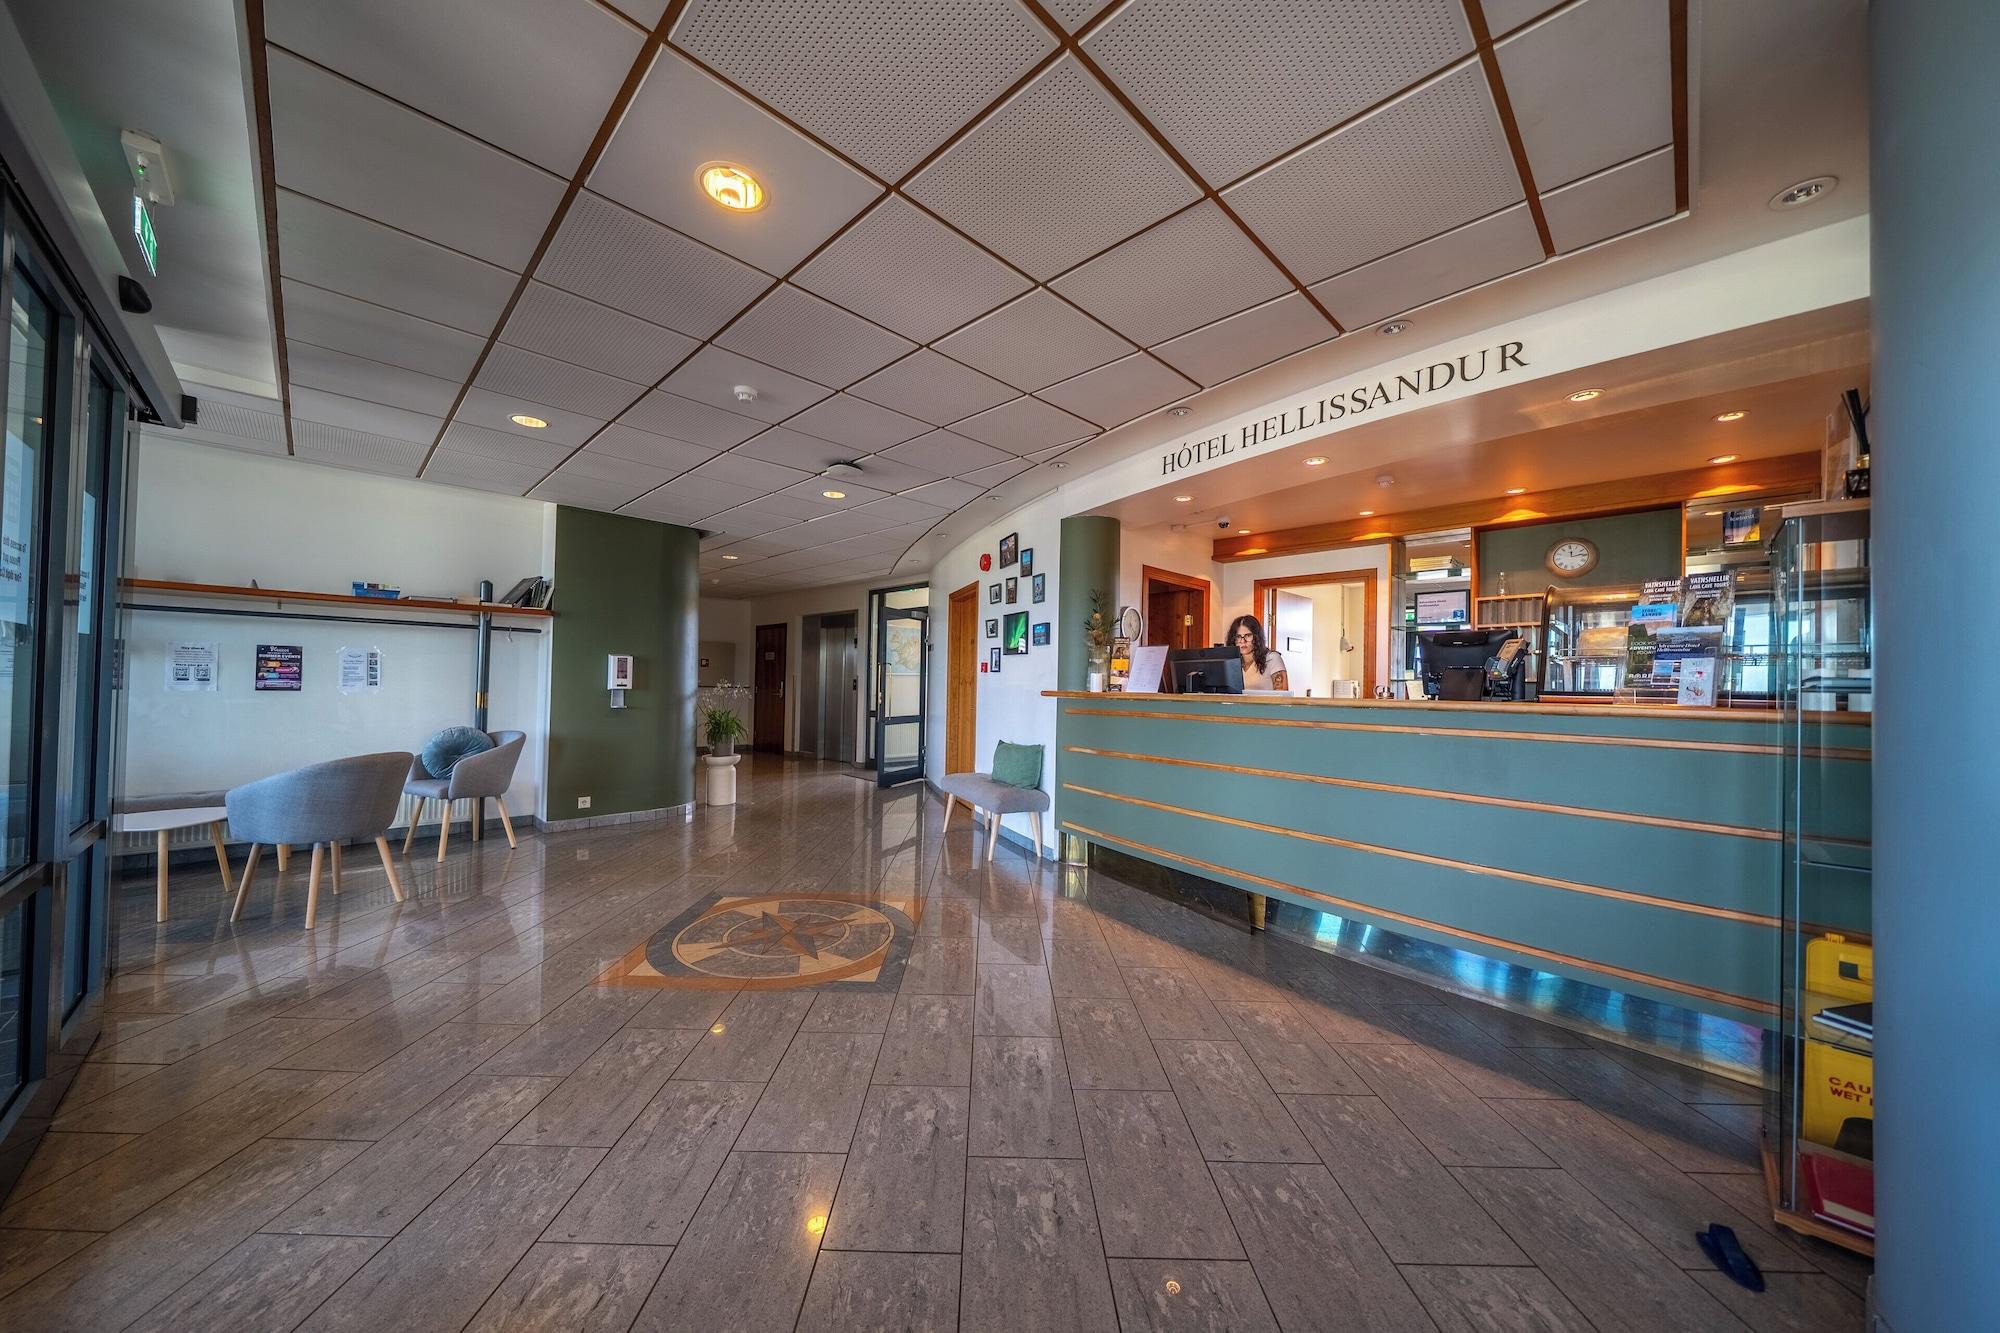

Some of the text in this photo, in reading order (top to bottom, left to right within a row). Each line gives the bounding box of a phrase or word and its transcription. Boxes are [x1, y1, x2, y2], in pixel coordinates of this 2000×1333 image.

[1161, 341, 1530, 475] HÓTEL HELLISSANDUR
[1644, 579, 1681, 588] VATNSHELLIR
[1690, 574, 1730, 584] VATNSHELLIR
[1830, 1086, 1863, 1102] WET
